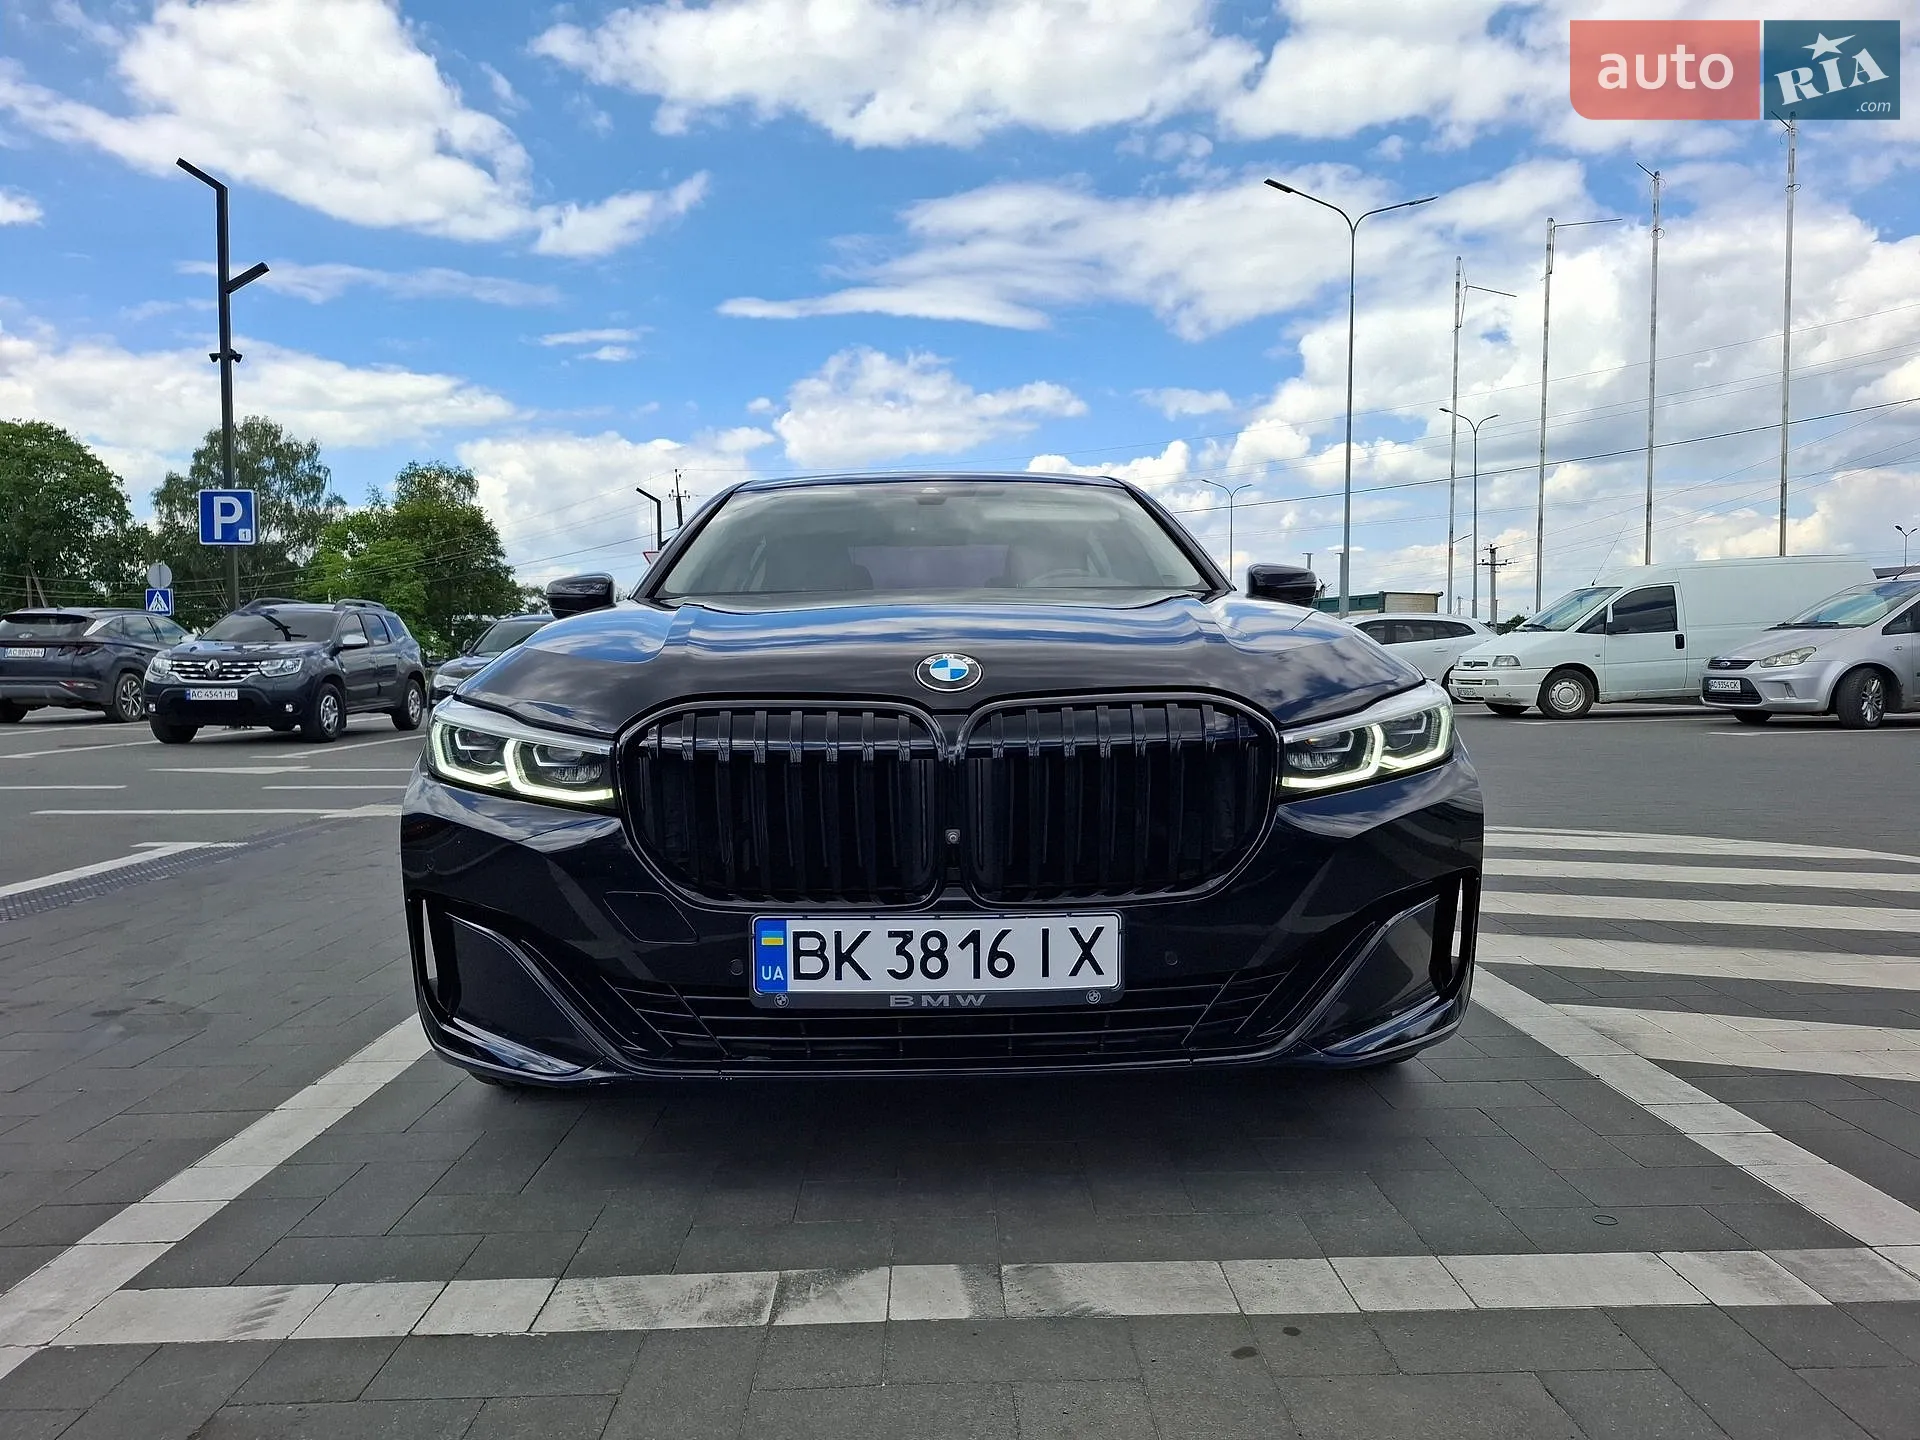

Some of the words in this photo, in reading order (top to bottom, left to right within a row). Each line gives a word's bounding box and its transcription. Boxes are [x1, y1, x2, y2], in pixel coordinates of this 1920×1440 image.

[213, 496, 243, 540] P
[923, 653, 974, 665] BMW
[204, 690, 223, 699] 4541
[791, 929, 872, 981] BK
[886, 929, 1016, 981] 3816
[761, 965, 784, 981] UA
[889, 994, 987, 1008] BMW
